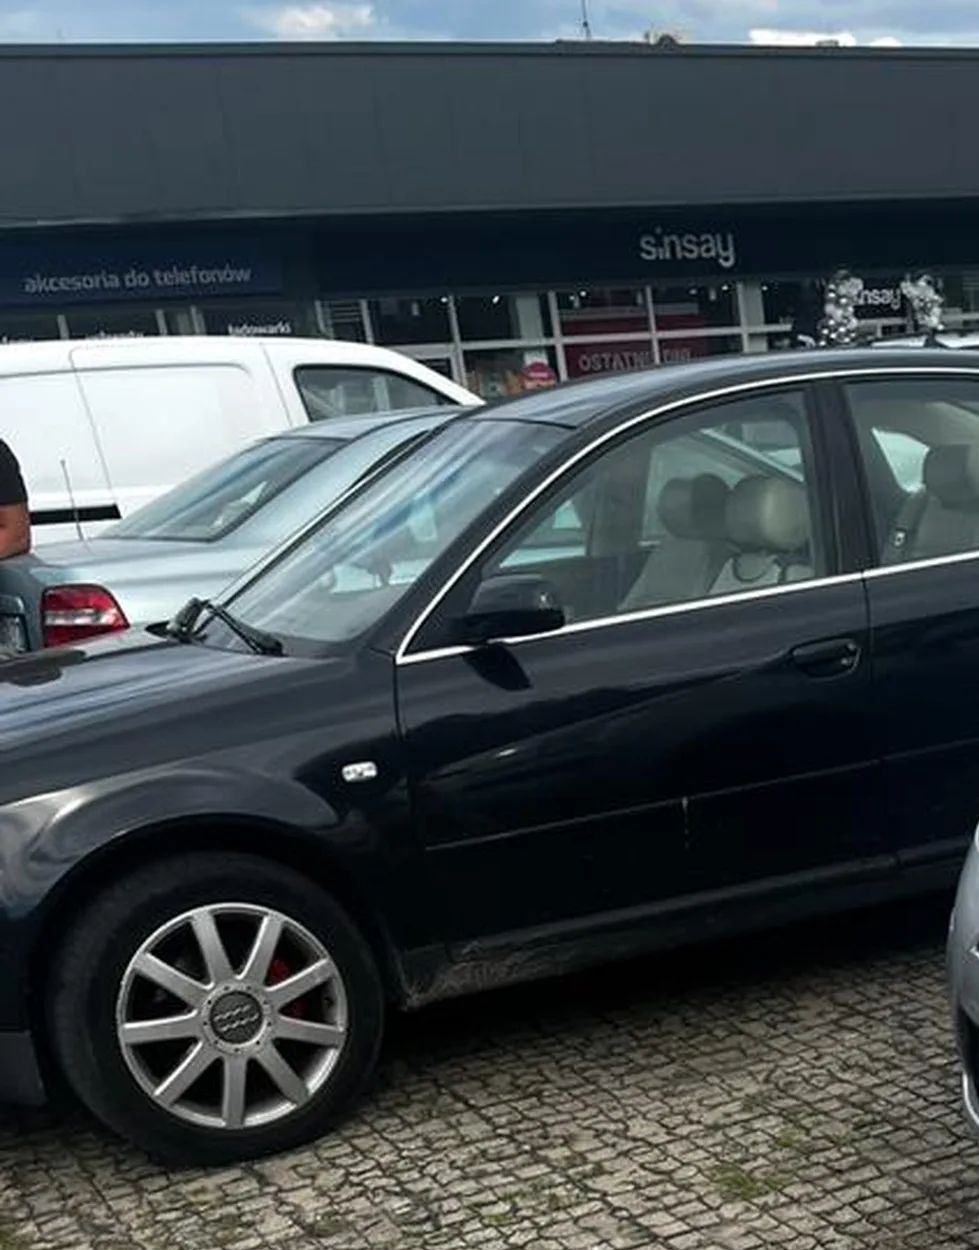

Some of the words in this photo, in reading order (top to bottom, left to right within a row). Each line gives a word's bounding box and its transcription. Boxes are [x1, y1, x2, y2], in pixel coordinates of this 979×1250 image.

[640, 227, 736, 268] sinsay
[24, 273, 119, 293] akcesoria
[124, 269, 150, 288] do
[153, 262, 251, 286] telefonów
